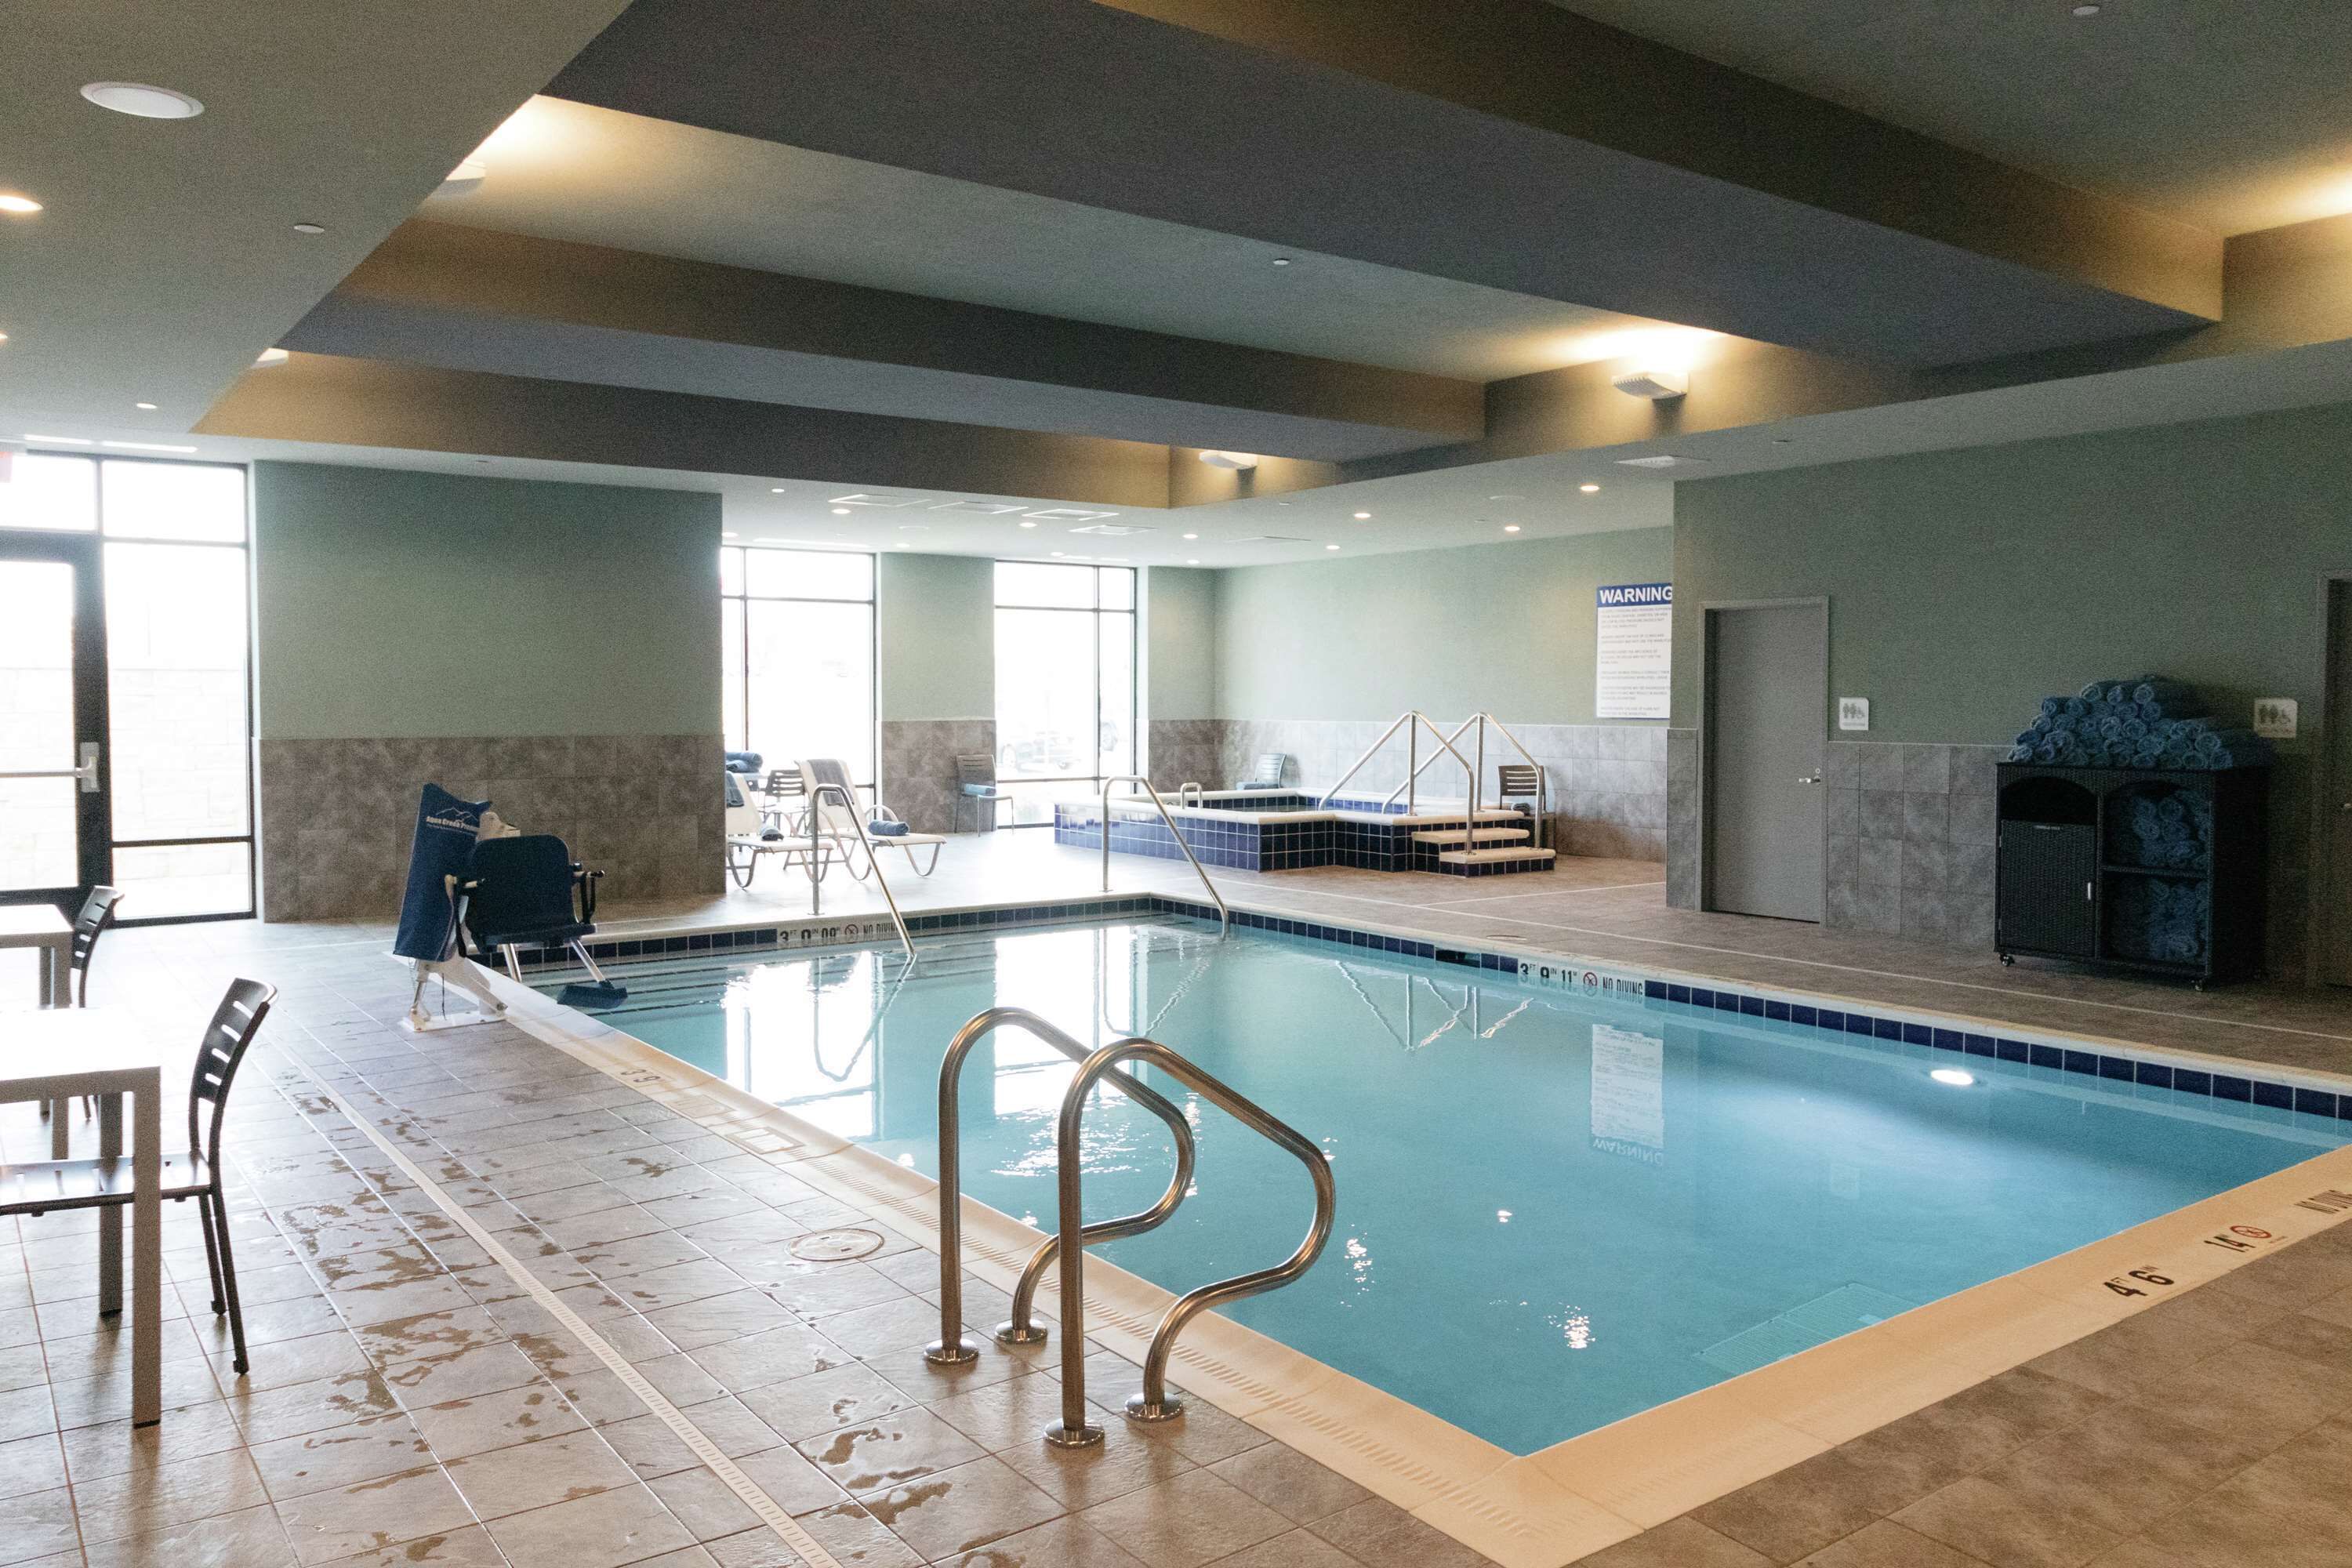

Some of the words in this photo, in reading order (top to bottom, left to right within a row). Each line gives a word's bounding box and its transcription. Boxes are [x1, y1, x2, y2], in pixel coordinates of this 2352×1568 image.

[1599, 586, 1672, 604] WARNING
[2103, 1281, 2148, 1297] 4
[2128, 1269, 2175, 1285] 6
